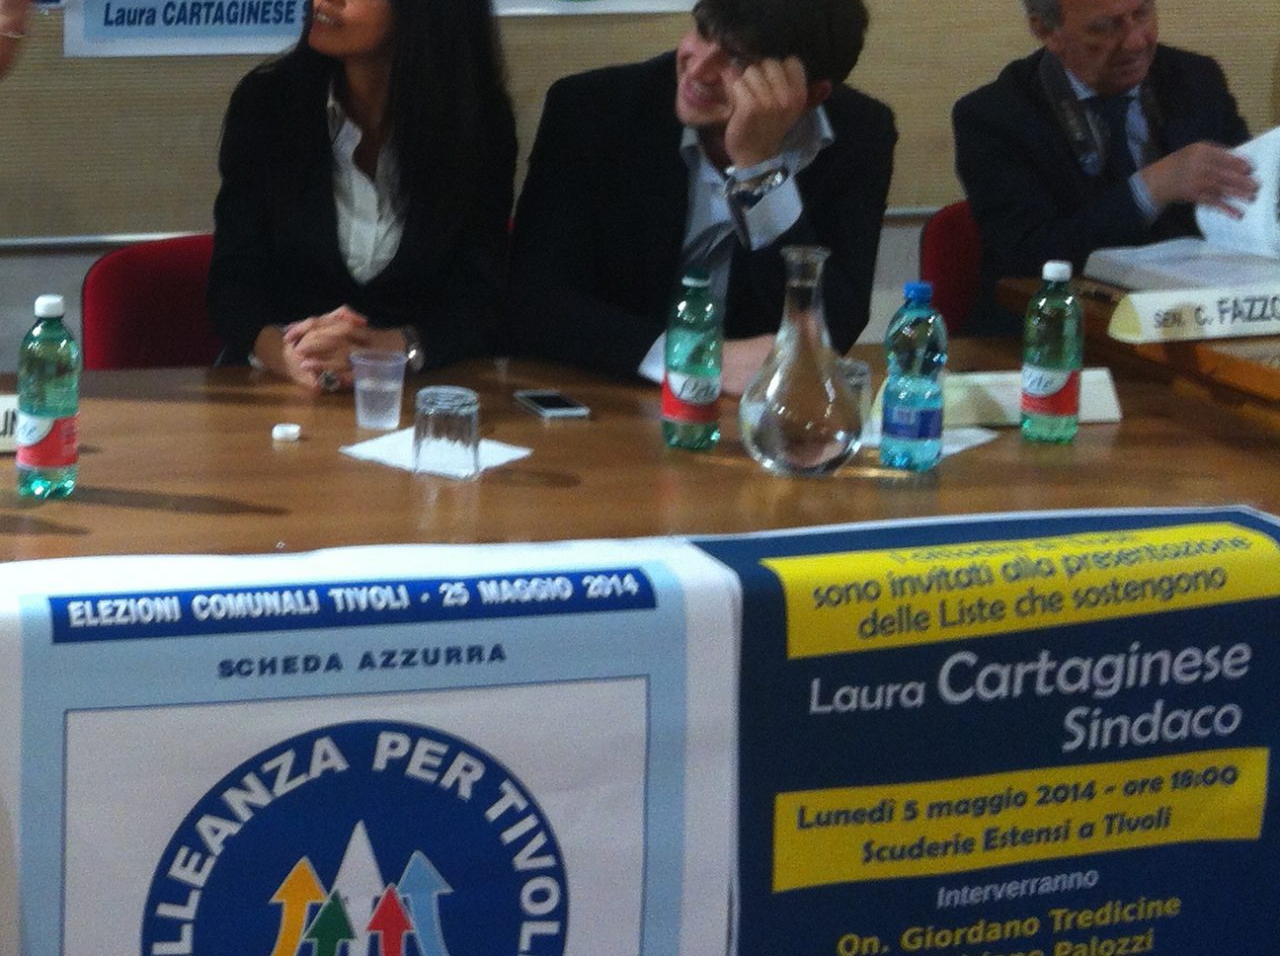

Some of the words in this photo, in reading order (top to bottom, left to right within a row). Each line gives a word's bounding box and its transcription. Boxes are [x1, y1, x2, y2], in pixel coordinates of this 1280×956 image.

[103, 1, 156, 27] Laura
[161, 0, 297, 26] CARTAGINESE
[68, 594, 180, 629] ELEZIONI
[192, 589, 319, 621] COMUNALI
[328, 583, 410, 615] TIVOLI
[439, 580, 470, 607] 25
[480, 575, 572, 606] MAGGIO
[582, 572, 639, 599] 2014
[813, 576, 881, 610] sono
[887, 560, 993, 599] invitati
[1002, 553, 1056, 582] alla
[1062, 534, 1252, 580] presentazione
[856, 604, 931, 641] delle
[939, 596, 1006, 628] Liste
[1014, 587, 1064, 618] che
[1072, 565, 1227, 611] sostengono
[218, 650, 344, 680] SCHEDA
[357, 642, 507, 671] AZZURRA
[808, 676, 926, 715] Laura
[937, 641, 1253, 706] Cartaginese
[1061, 699, 1243, 753] Sindaco
[371, 730, 486, 802] PER
[902, 799, 919, 822] 5
[926, 785, 1027, 820] maggio
[1037, 779, 1096, 805] 2014
[1123, 774, 1162, 798] ore
[1170, 764, 1239, 791] 18:00
[861, 840, 975, 865] Scuderie
[982, 819, 1072, 852] Estensi
[1078, 822, 1094, 841] a
[1104, 806, 1171, 835] Tivoli
[936, 869, 1100, 910] Interverranno
[836, 932, 890, 956] On.
[899, 912, 1041, 952] Giordano
[1049, 895, 1183, 933] Tredicine
